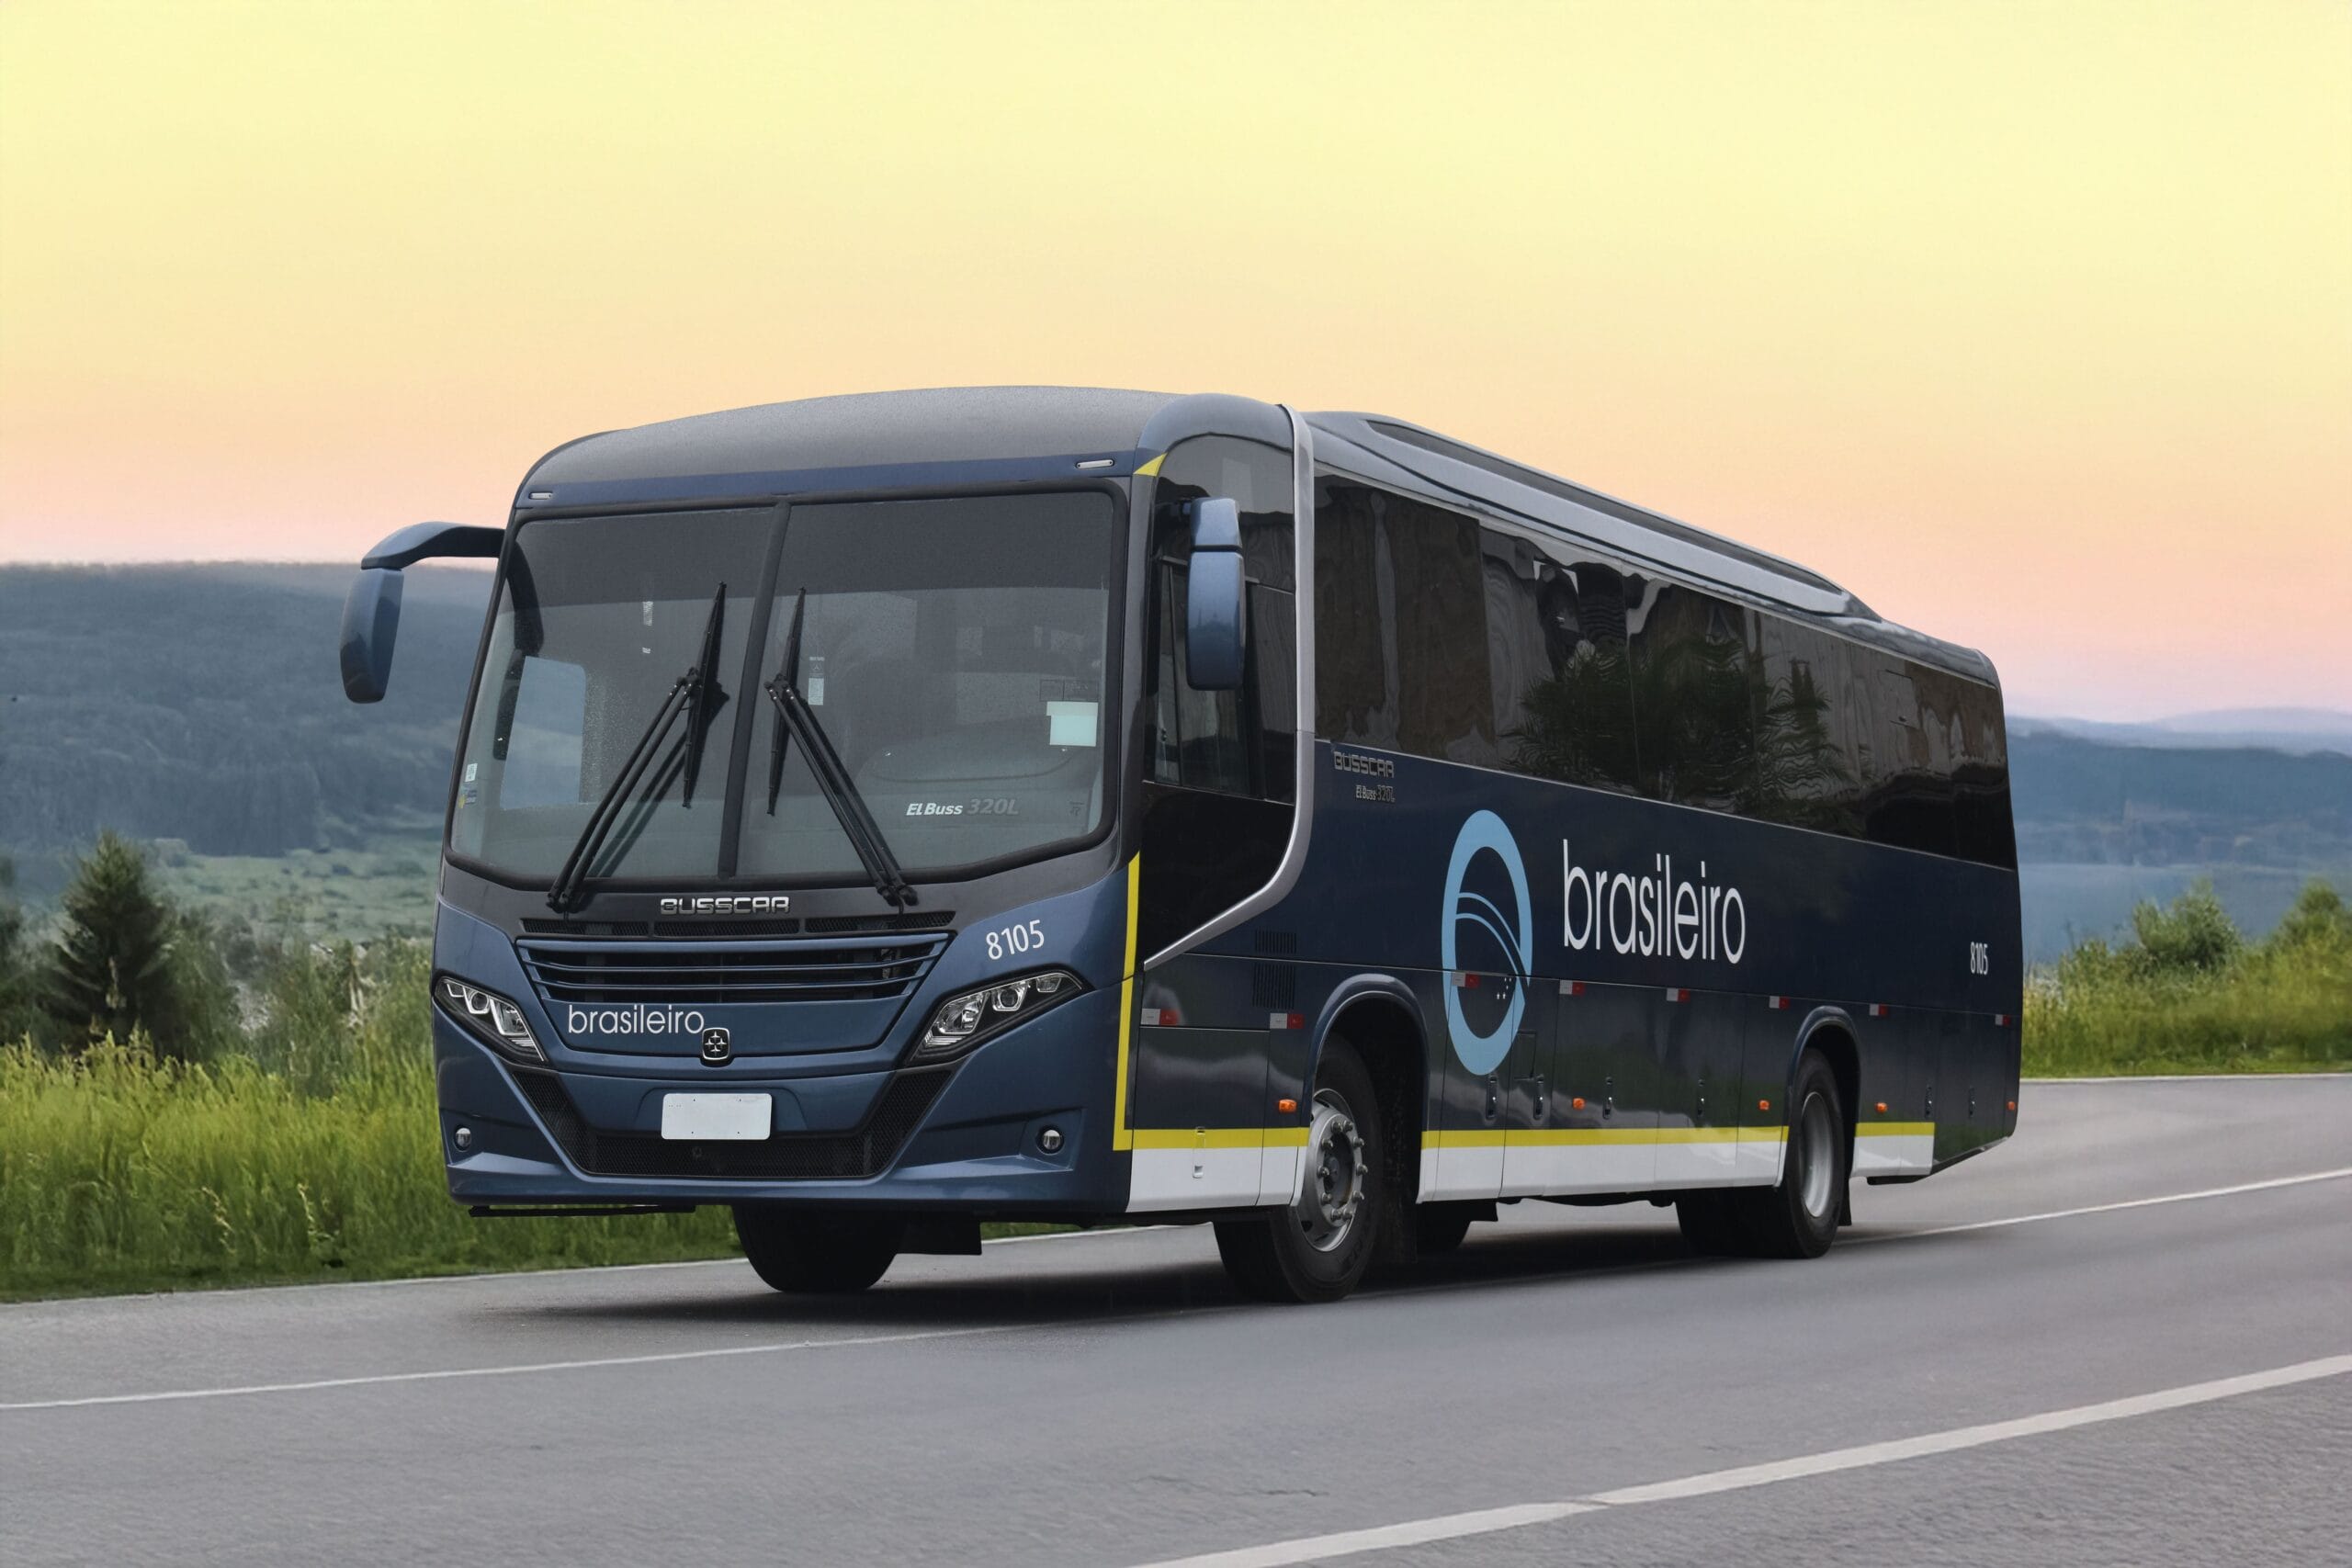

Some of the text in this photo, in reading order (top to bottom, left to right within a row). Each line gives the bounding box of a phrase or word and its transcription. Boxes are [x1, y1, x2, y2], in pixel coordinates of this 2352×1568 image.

[1334, 751, 1395, 778] BUSSCAR
[967, 798, 1020, 816] 320L
[660, 897, 790, 915] BUSSCAR
[1562, 839, 1746, 964] brasileiro
[986, 919, 1045, 960] 8105
[1970, 941, 1988, 976] 8105
[568, 1004, 705, 1034] brasileiro
